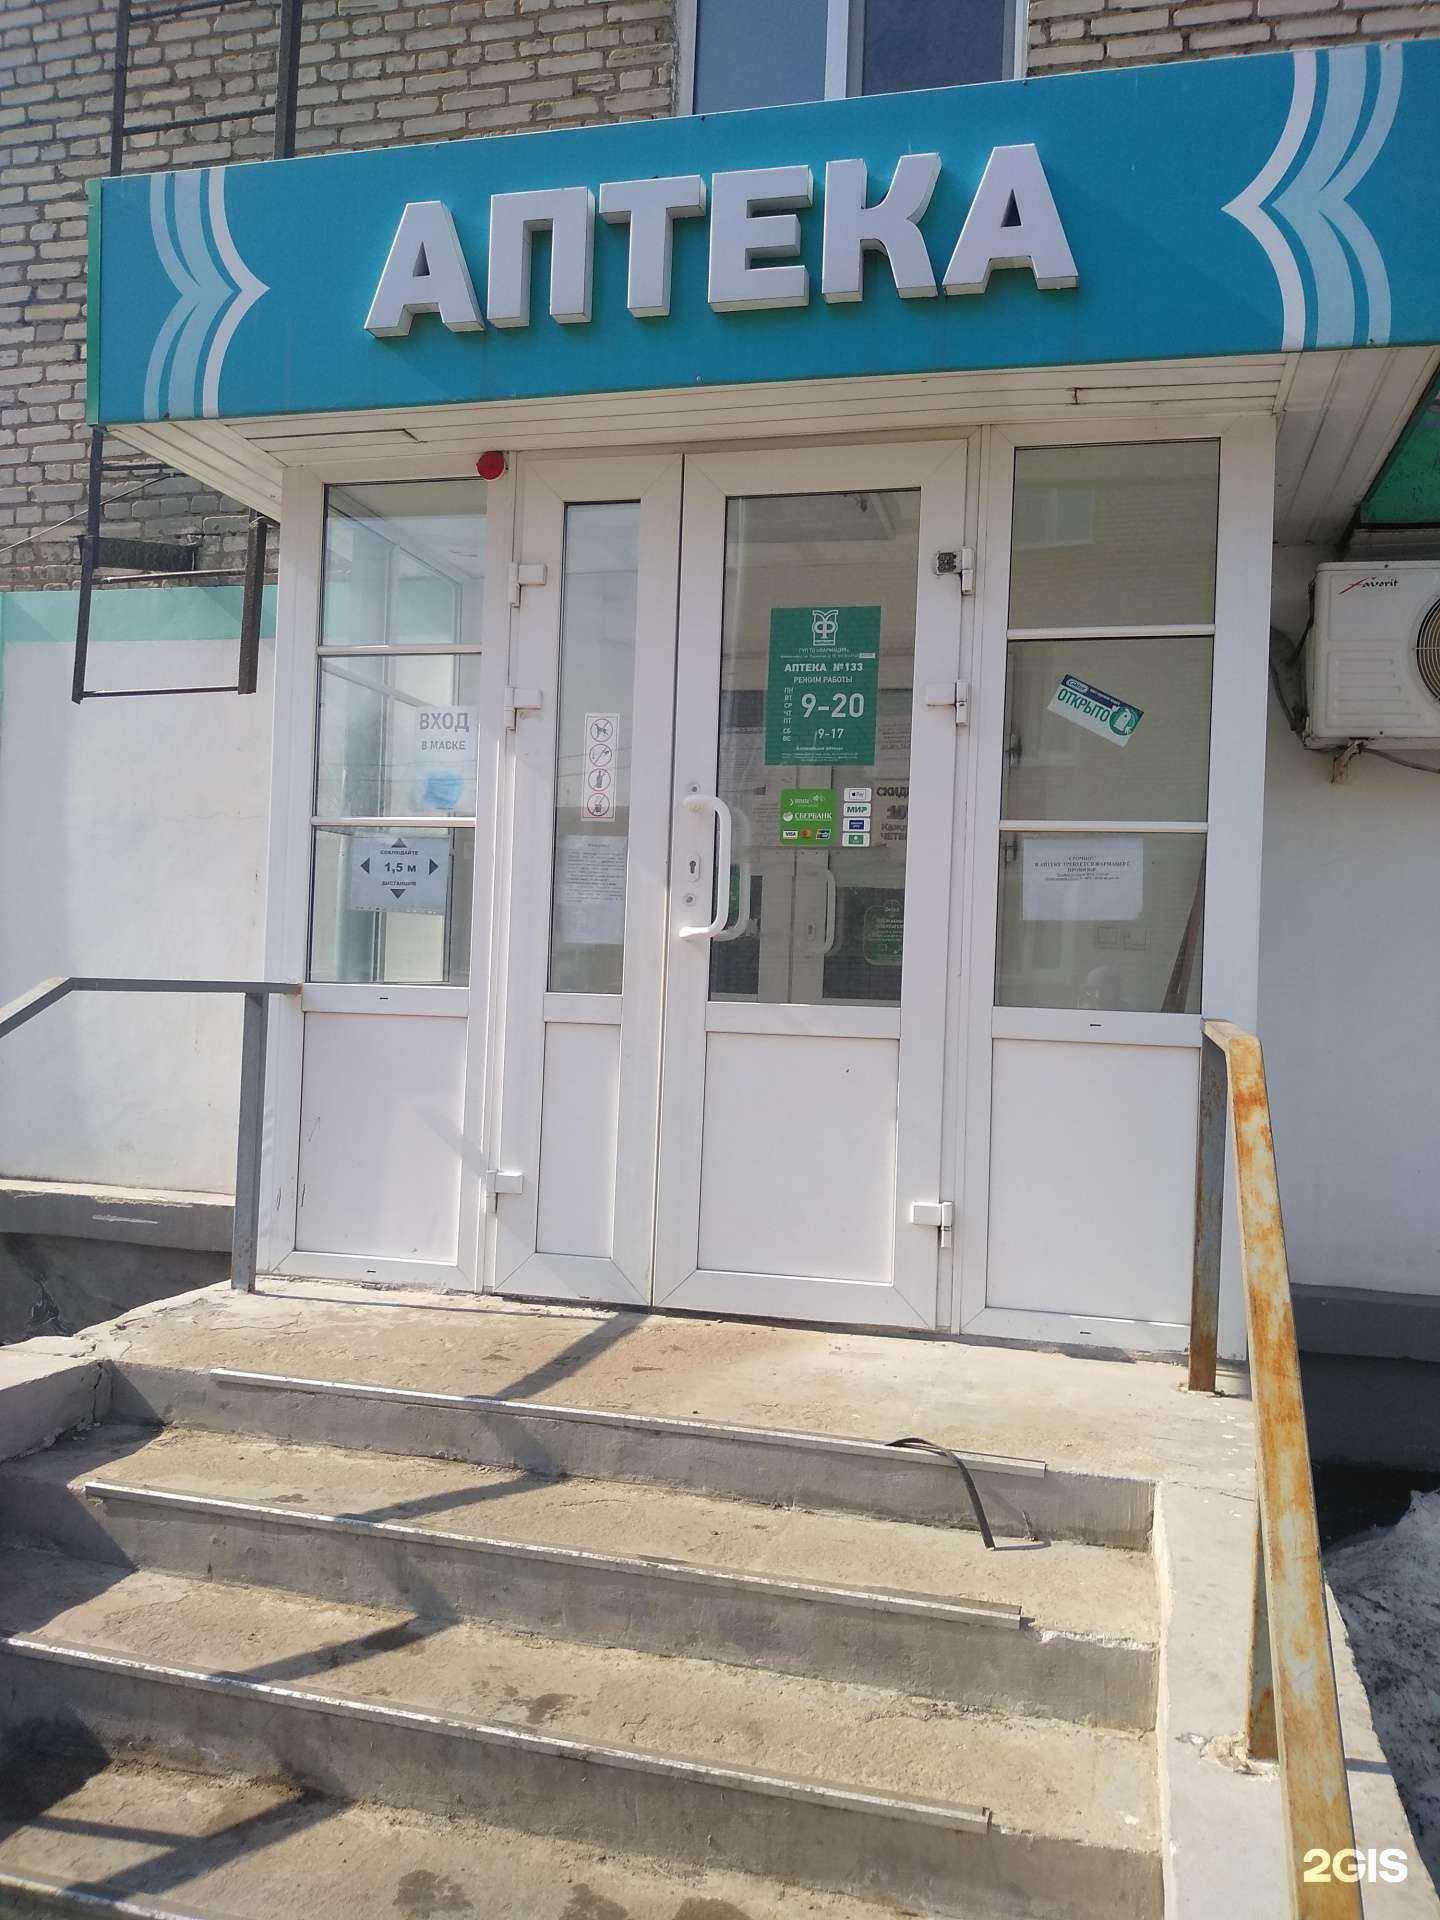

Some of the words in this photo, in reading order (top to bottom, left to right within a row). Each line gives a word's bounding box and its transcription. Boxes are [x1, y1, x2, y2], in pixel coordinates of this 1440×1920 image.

[364, 143, 1078, 338] АПТЕКА
[784, 663, 827, 672] АПТЕКА
[833, 662, 864, 672] №133
[793, 676, 822, 684] РЕЖИМ
[823, 675, 853, 683] РАБОТЫ
[801, 693, 865, 718] 9-20
[1057, 688, 1111, 722] ОТКРЫТО
[419, 712, 470, 732] ВХОД
[818, 728, 844, 739] 9-17
[421, 740, 427, 750] В
[430, 740, 466, 750] МАСКЕ
[794, 812, 833, 820] СБЕРБАНК
[384, 862, 403, 874] 1,5
